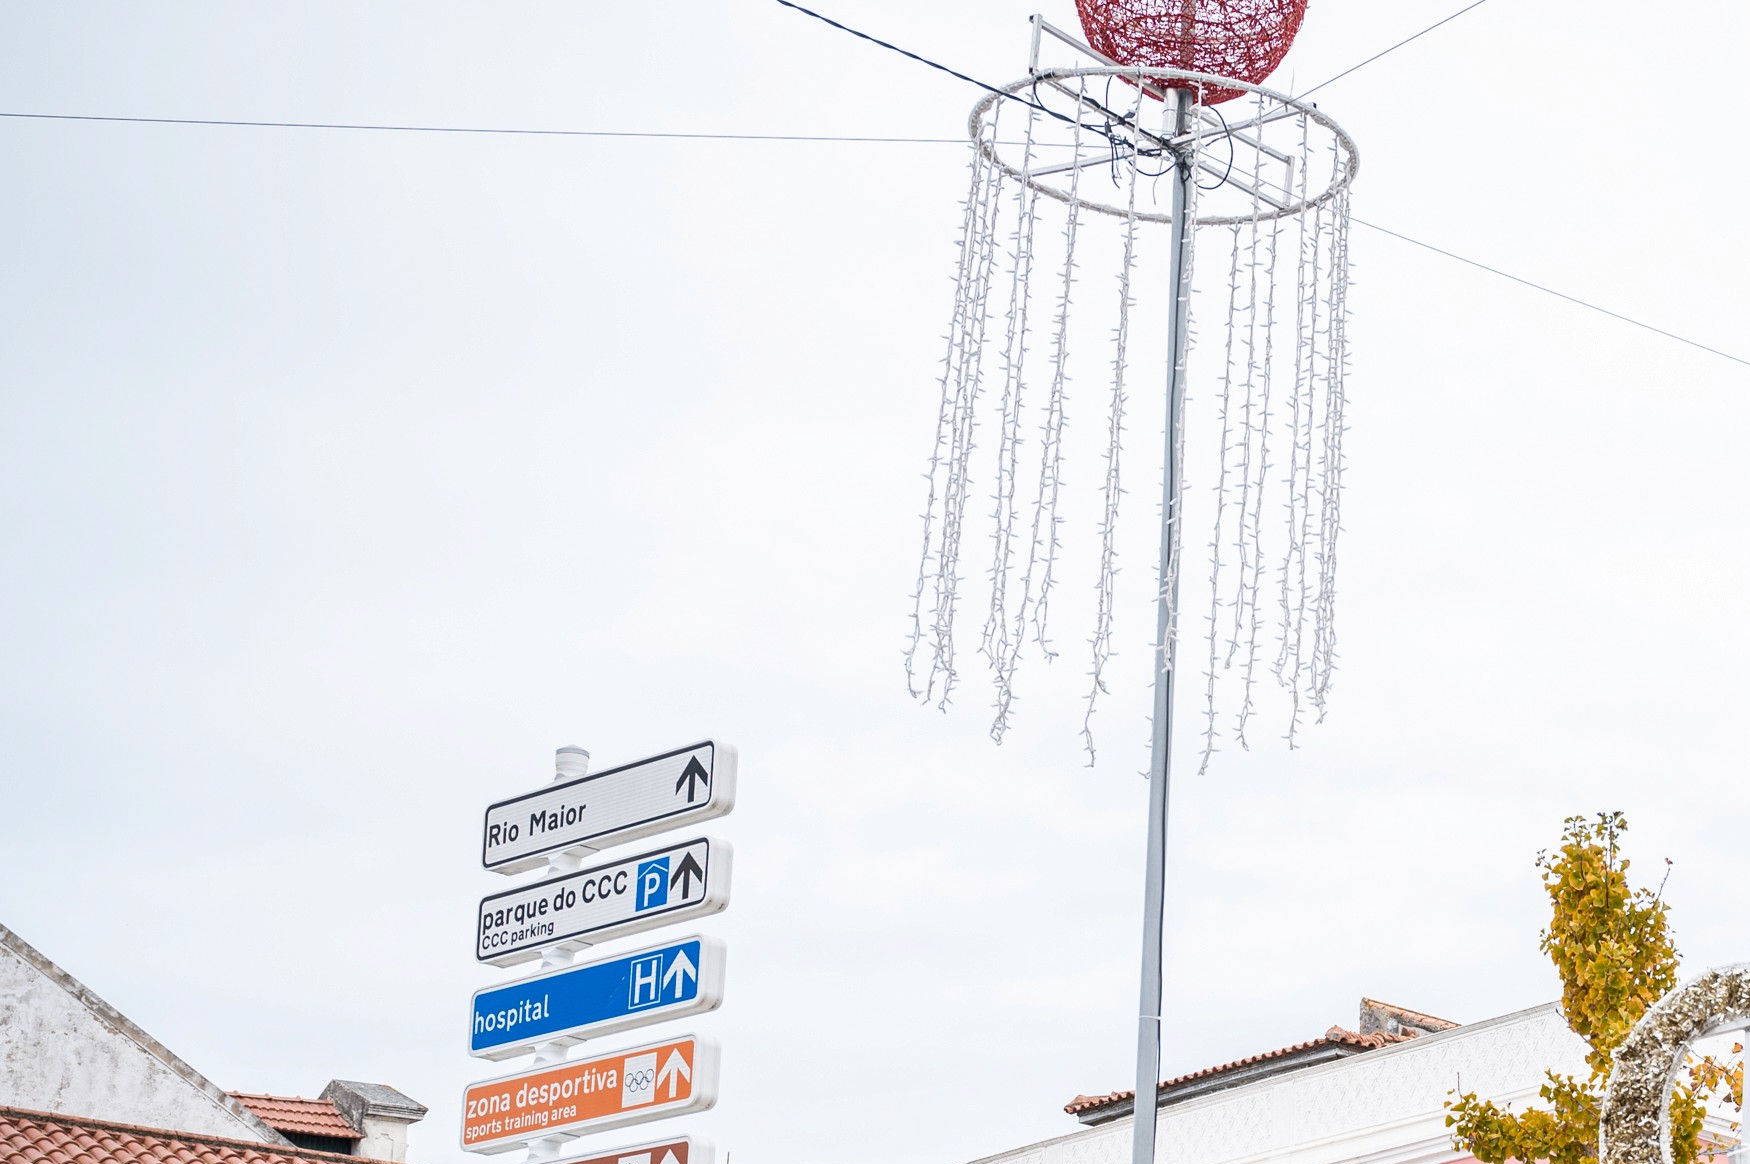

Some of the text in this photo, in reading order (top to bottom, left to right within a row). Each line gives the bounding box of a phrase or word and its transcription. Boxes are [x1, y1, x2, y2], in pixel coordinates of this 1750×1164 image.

[487, 804, 586, 848] Rio Maior
[482, 870, 628, 935] parque do CCC
[482, 922, 554, 950] CCC parking
[474, 994, 549, 1034] hospital
[467, 1068, 618, 1118] zona desportiva
[466, 1105, 577, 1139] sports training area
